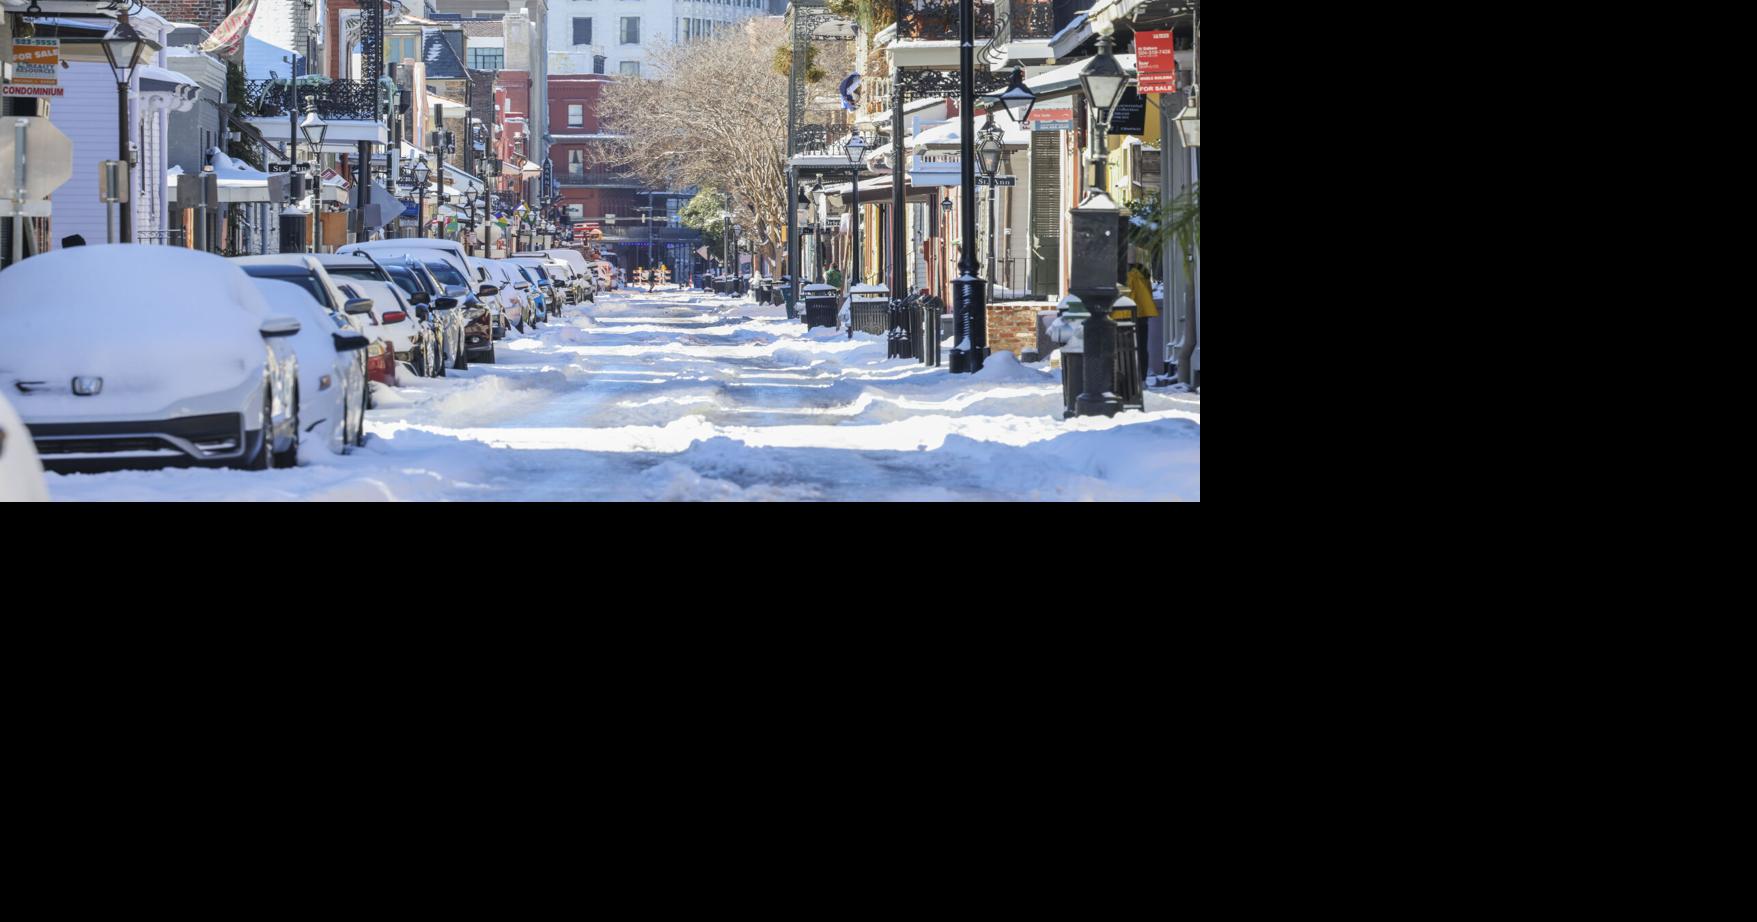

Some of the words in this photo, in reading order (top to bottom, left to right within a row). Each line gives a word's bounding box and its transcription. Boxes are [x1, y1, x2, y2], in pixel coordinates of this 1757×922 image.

[13, 52, 33, 61] FOR
[34, 49, 59, 58] SALE
[3, 86, 64, 96] CONDOMINIUM
